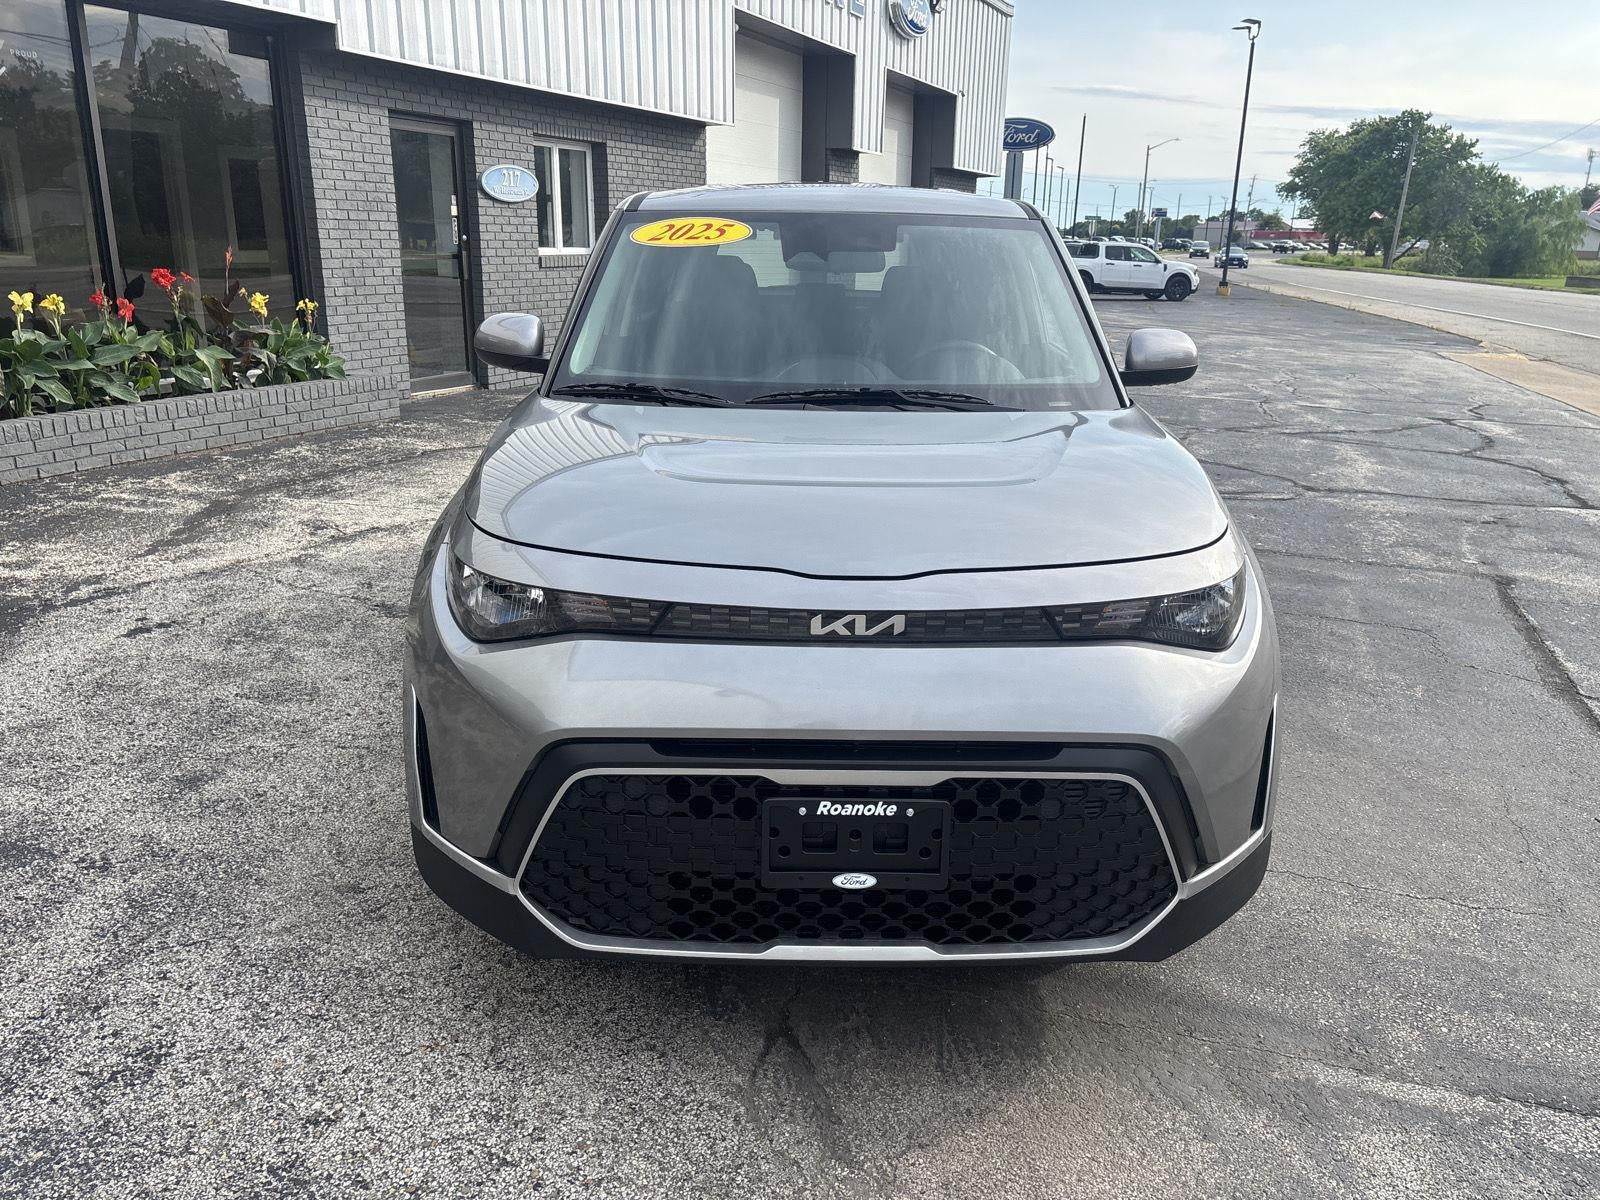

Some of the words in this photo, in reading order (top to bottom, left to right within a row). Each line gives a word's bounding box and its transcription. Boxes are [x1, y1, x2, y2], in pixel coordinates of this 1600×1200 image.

[9, 48, 38, 59] PROUD
[1004, 123, 1040, 144] Ford
[502, 169, 522, 188] 217
[647, 223, 736, 242] 2025
[810, 613, 906, 636] KIA
[816, 800, 898, 817] Roanoke
[840, 874, 868, 888] Ford
